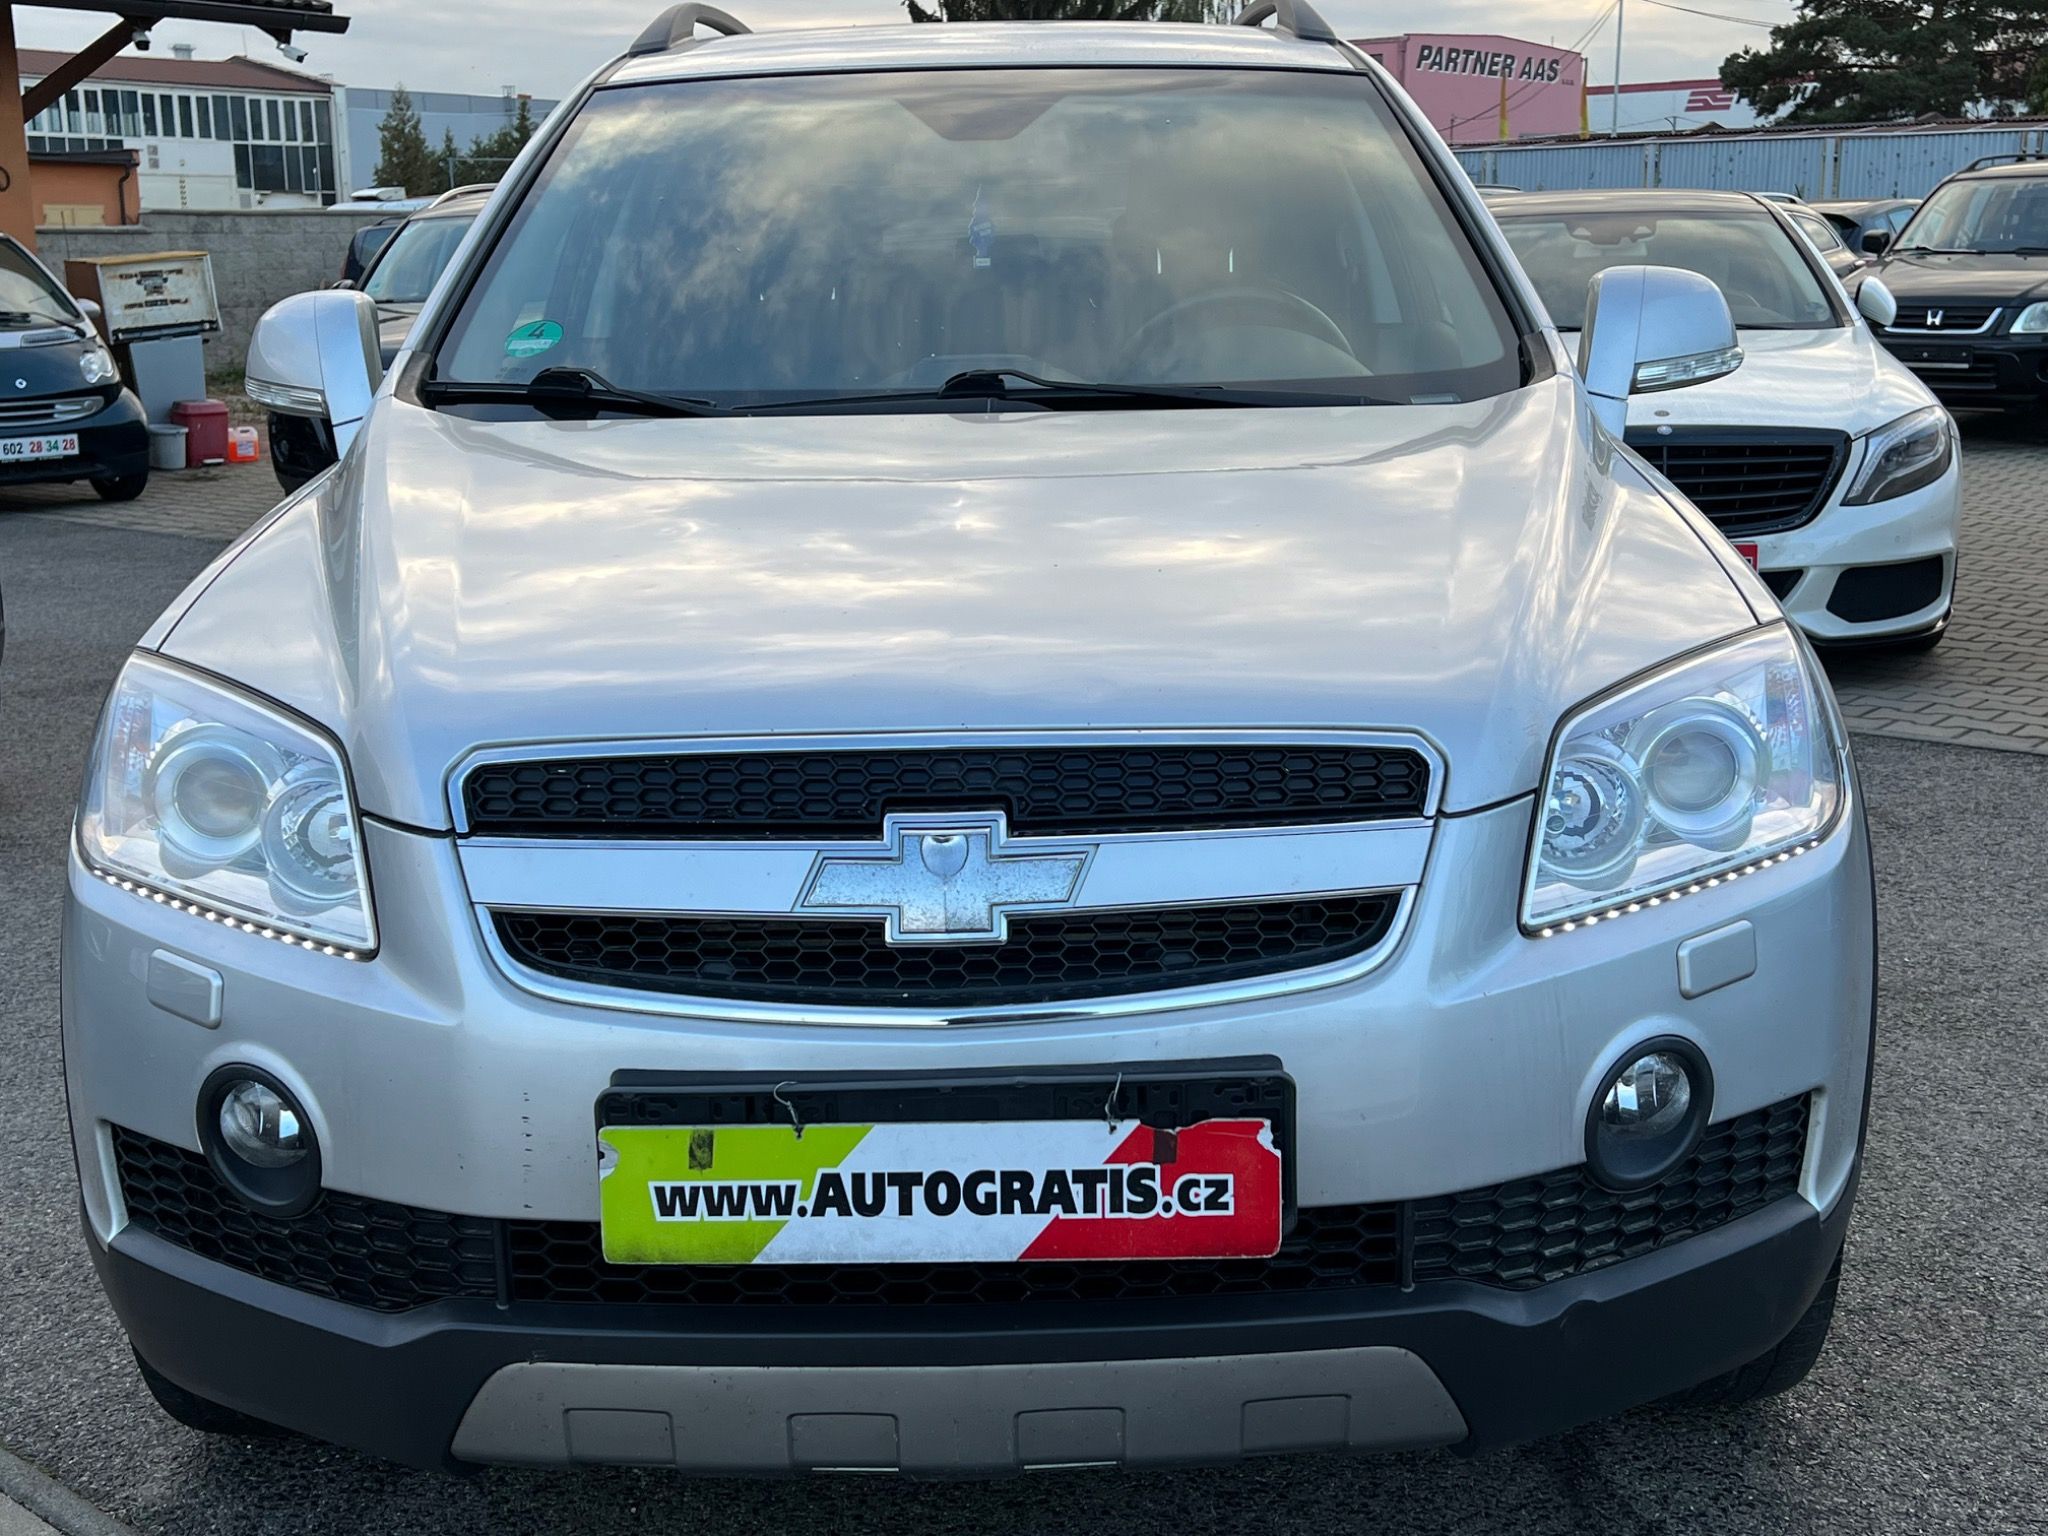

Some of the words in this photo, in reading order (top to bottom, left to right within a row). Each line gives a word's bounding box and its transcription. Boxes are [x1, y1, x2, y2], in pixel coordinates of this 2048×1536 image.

[1416, 45, 1514, 79] PARTNER
[1519, 56, 1560, 83] AAS
[528, 322, 546, 338] 4
[3, 443, 23, 455] 602
[29, 441, 43, 453] 28
[46, 440, 59, 452] 34
[62, 438, 75, 451] 28
[653, 1167, 1230, 1217] www.AUTOGRATIS.cz
